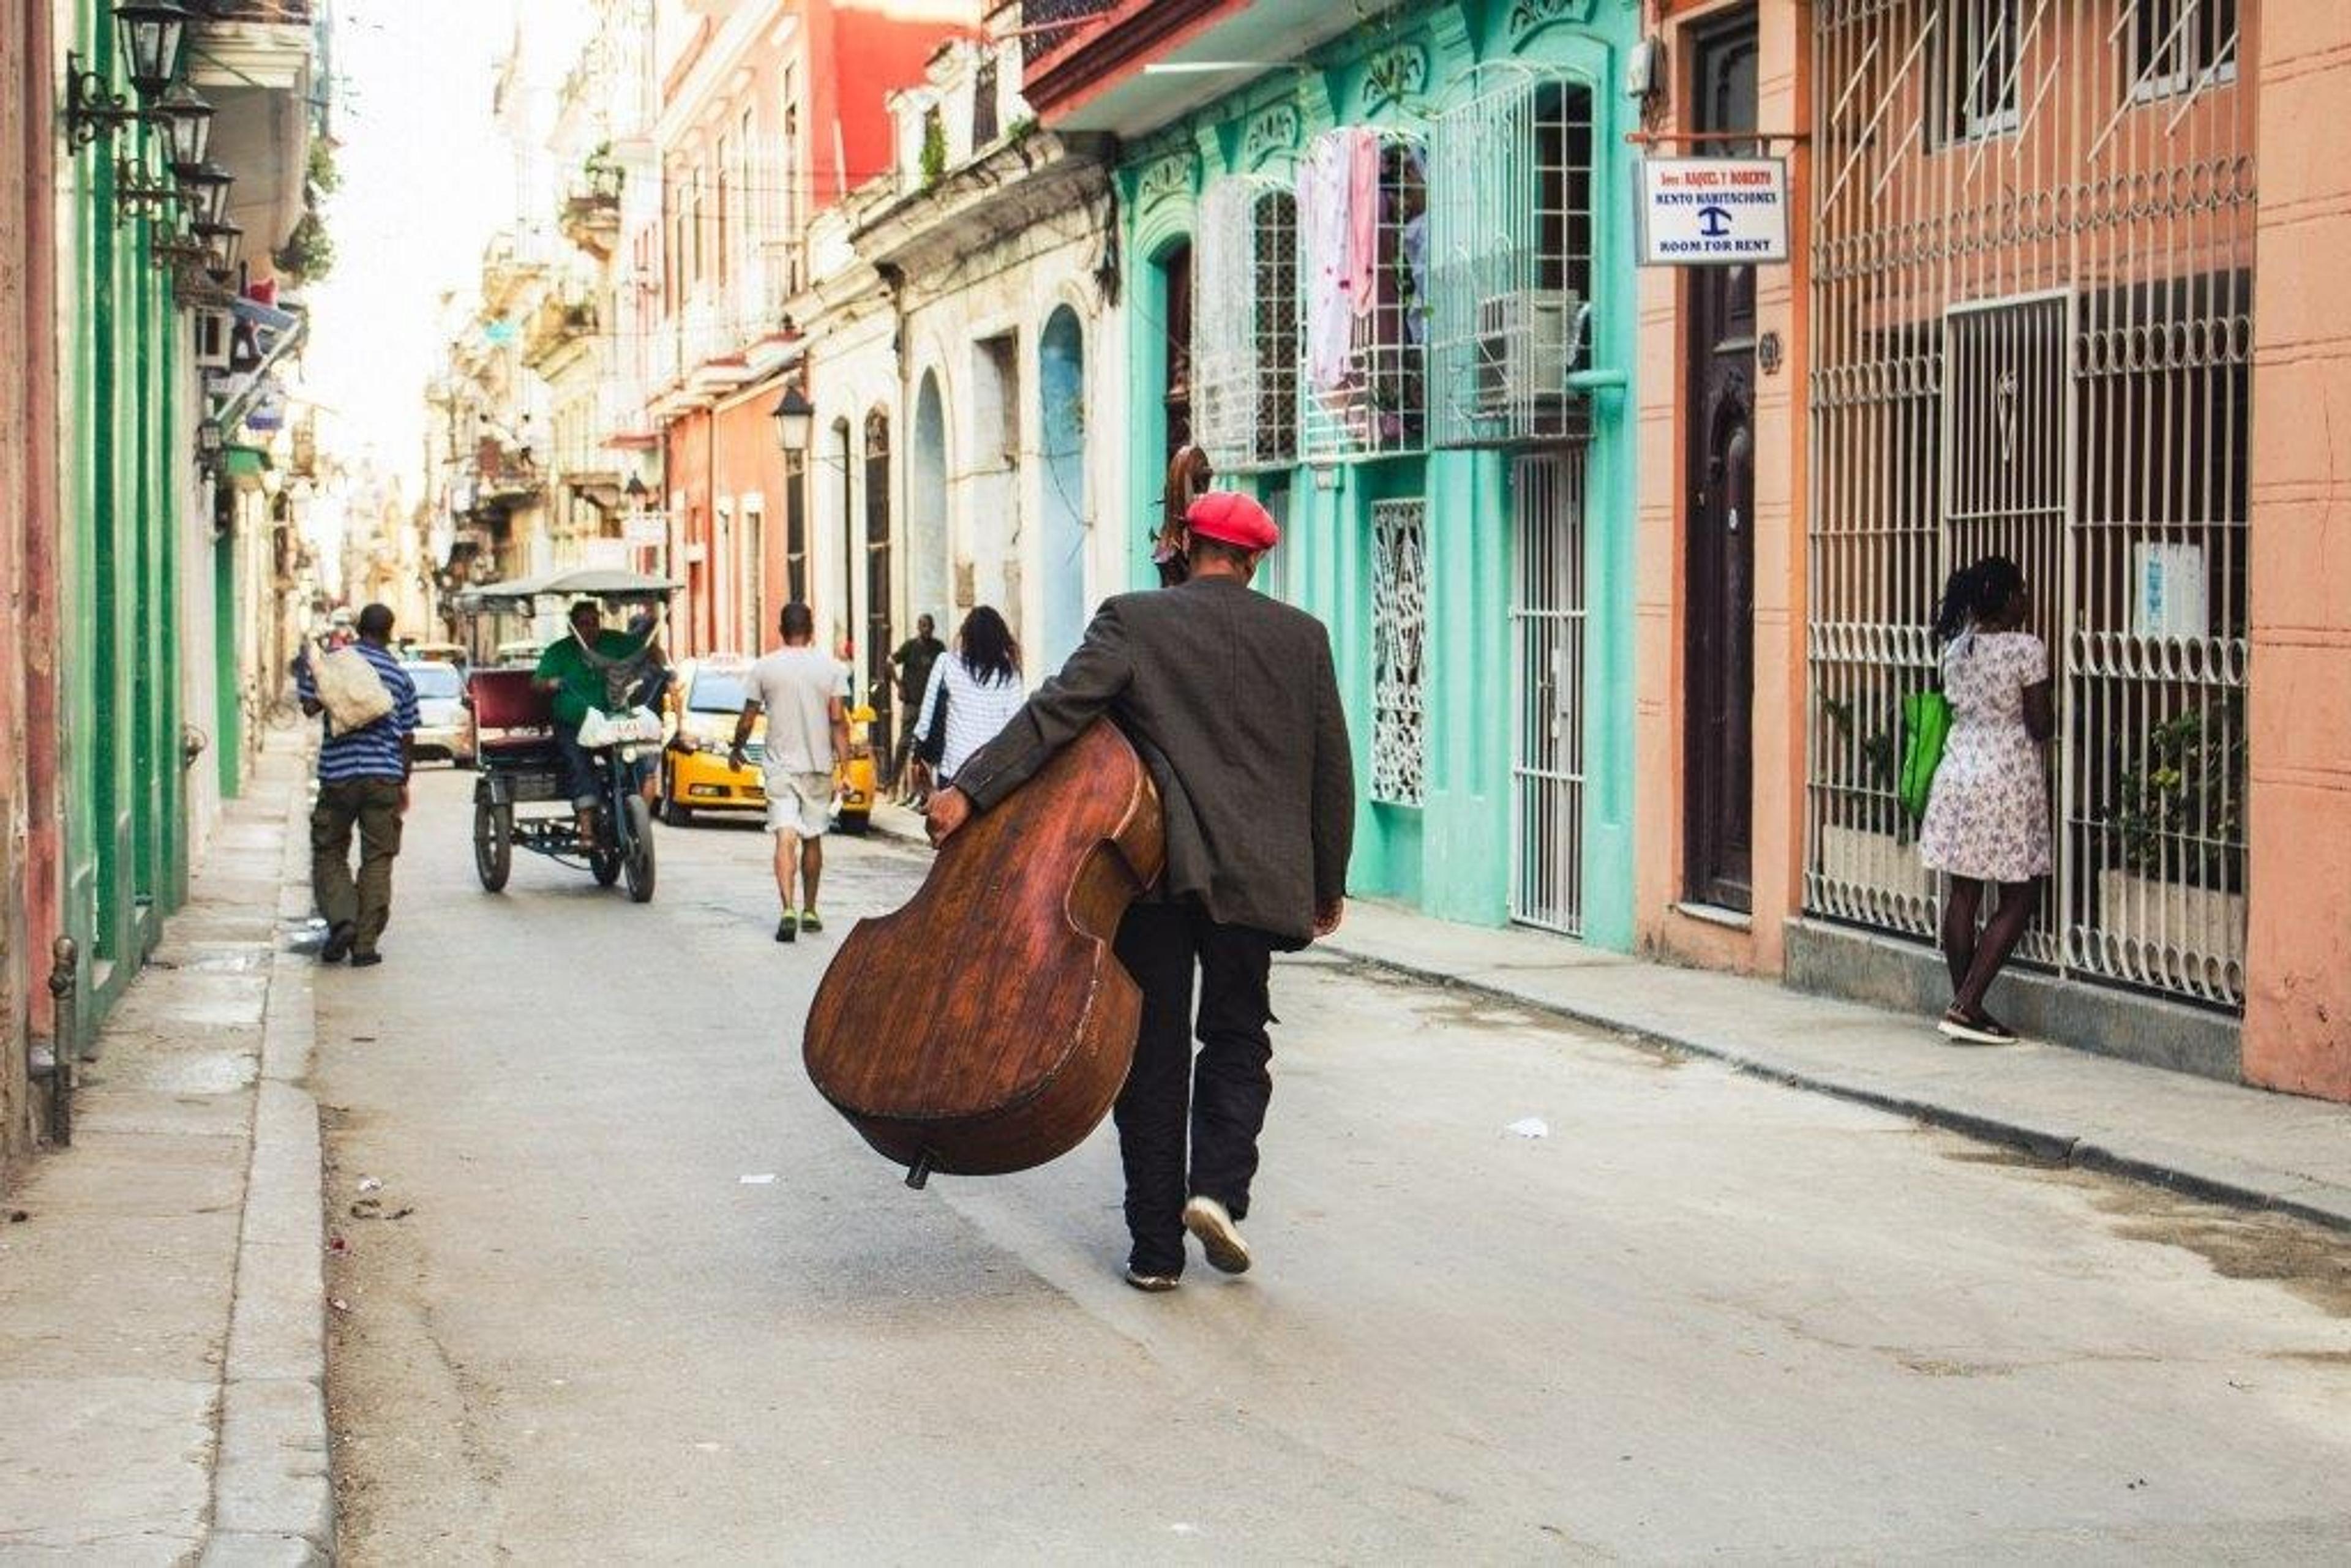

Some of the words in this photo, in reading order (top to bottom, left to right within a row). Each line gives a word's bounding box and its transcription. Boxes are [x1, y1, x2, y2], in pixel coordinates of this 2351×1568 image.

[1656, 193, 1693, 204] RENTO
[1660, 241, 1701, 252] ROOM
[1705, 240, 1732, 251] FOR
[1736, 239, 1770, 251] RENT
